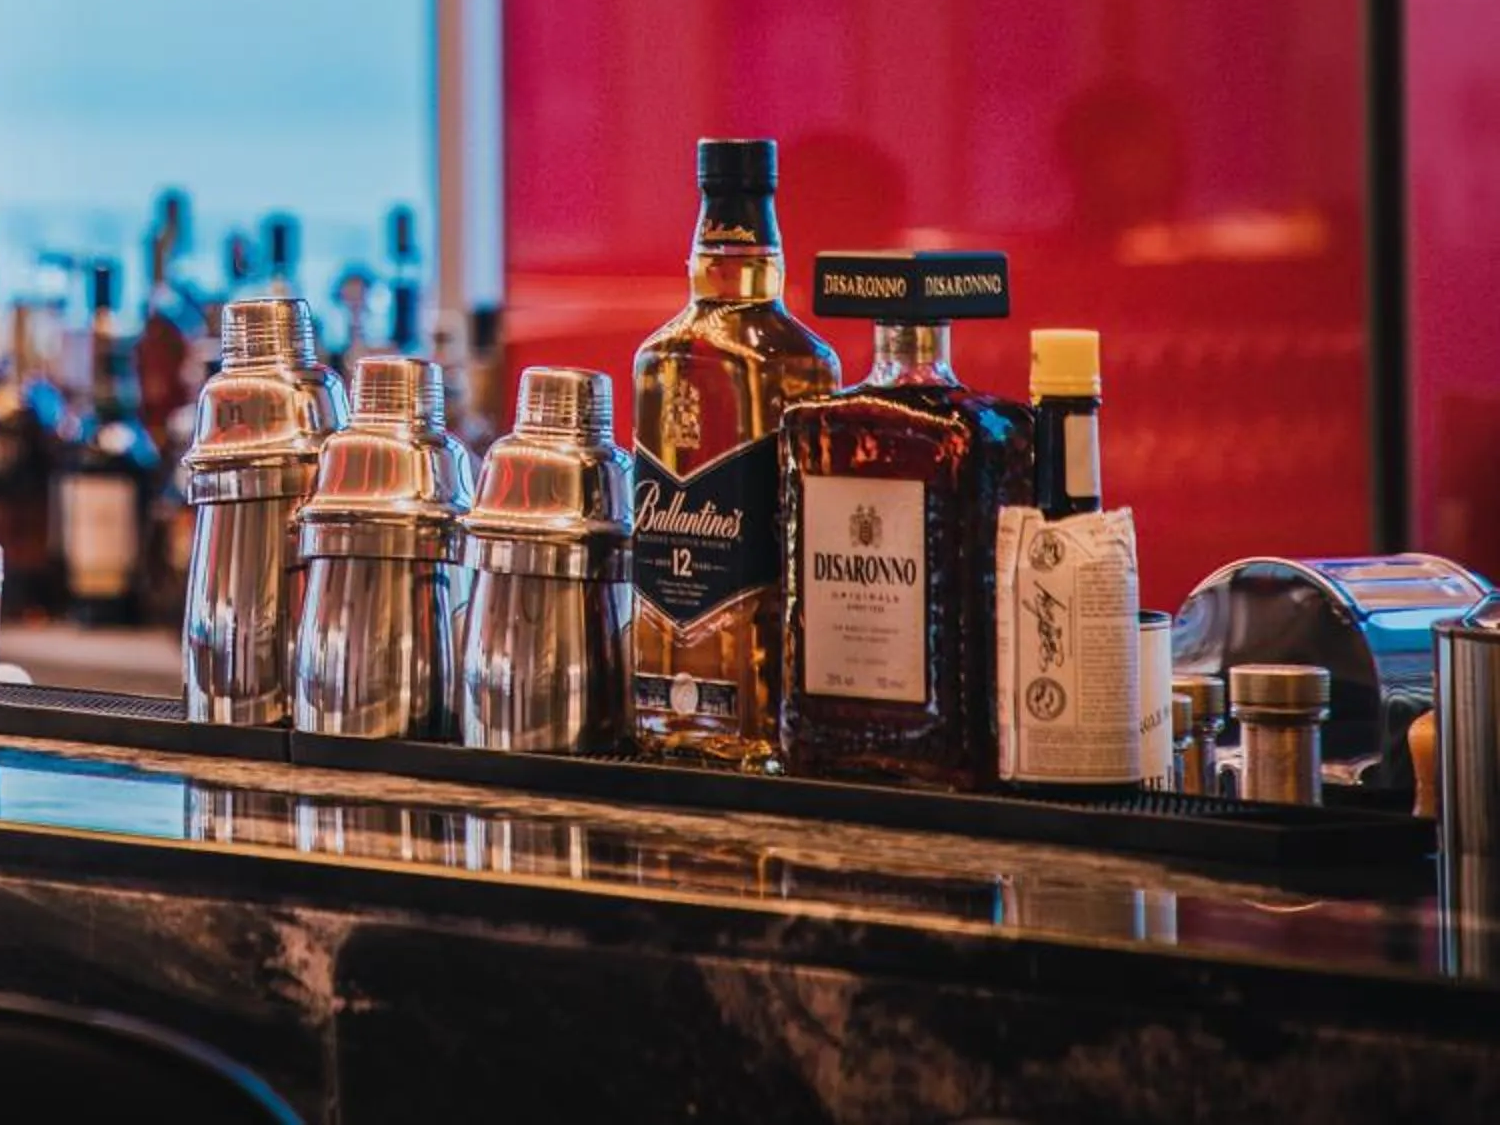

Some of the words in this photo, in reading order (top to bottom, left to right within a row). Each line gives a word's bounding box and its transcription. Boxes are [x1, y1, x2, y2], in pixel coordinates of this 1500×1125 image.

[823, 274, 907, 299] DISARONNO
[924, 273, 1002, 298] DISARONNO
[632, 479, 743, 539] Ballantine's
[672, 548, 693, 577] 12
[814, 551, 917, 587] DISARONNO
